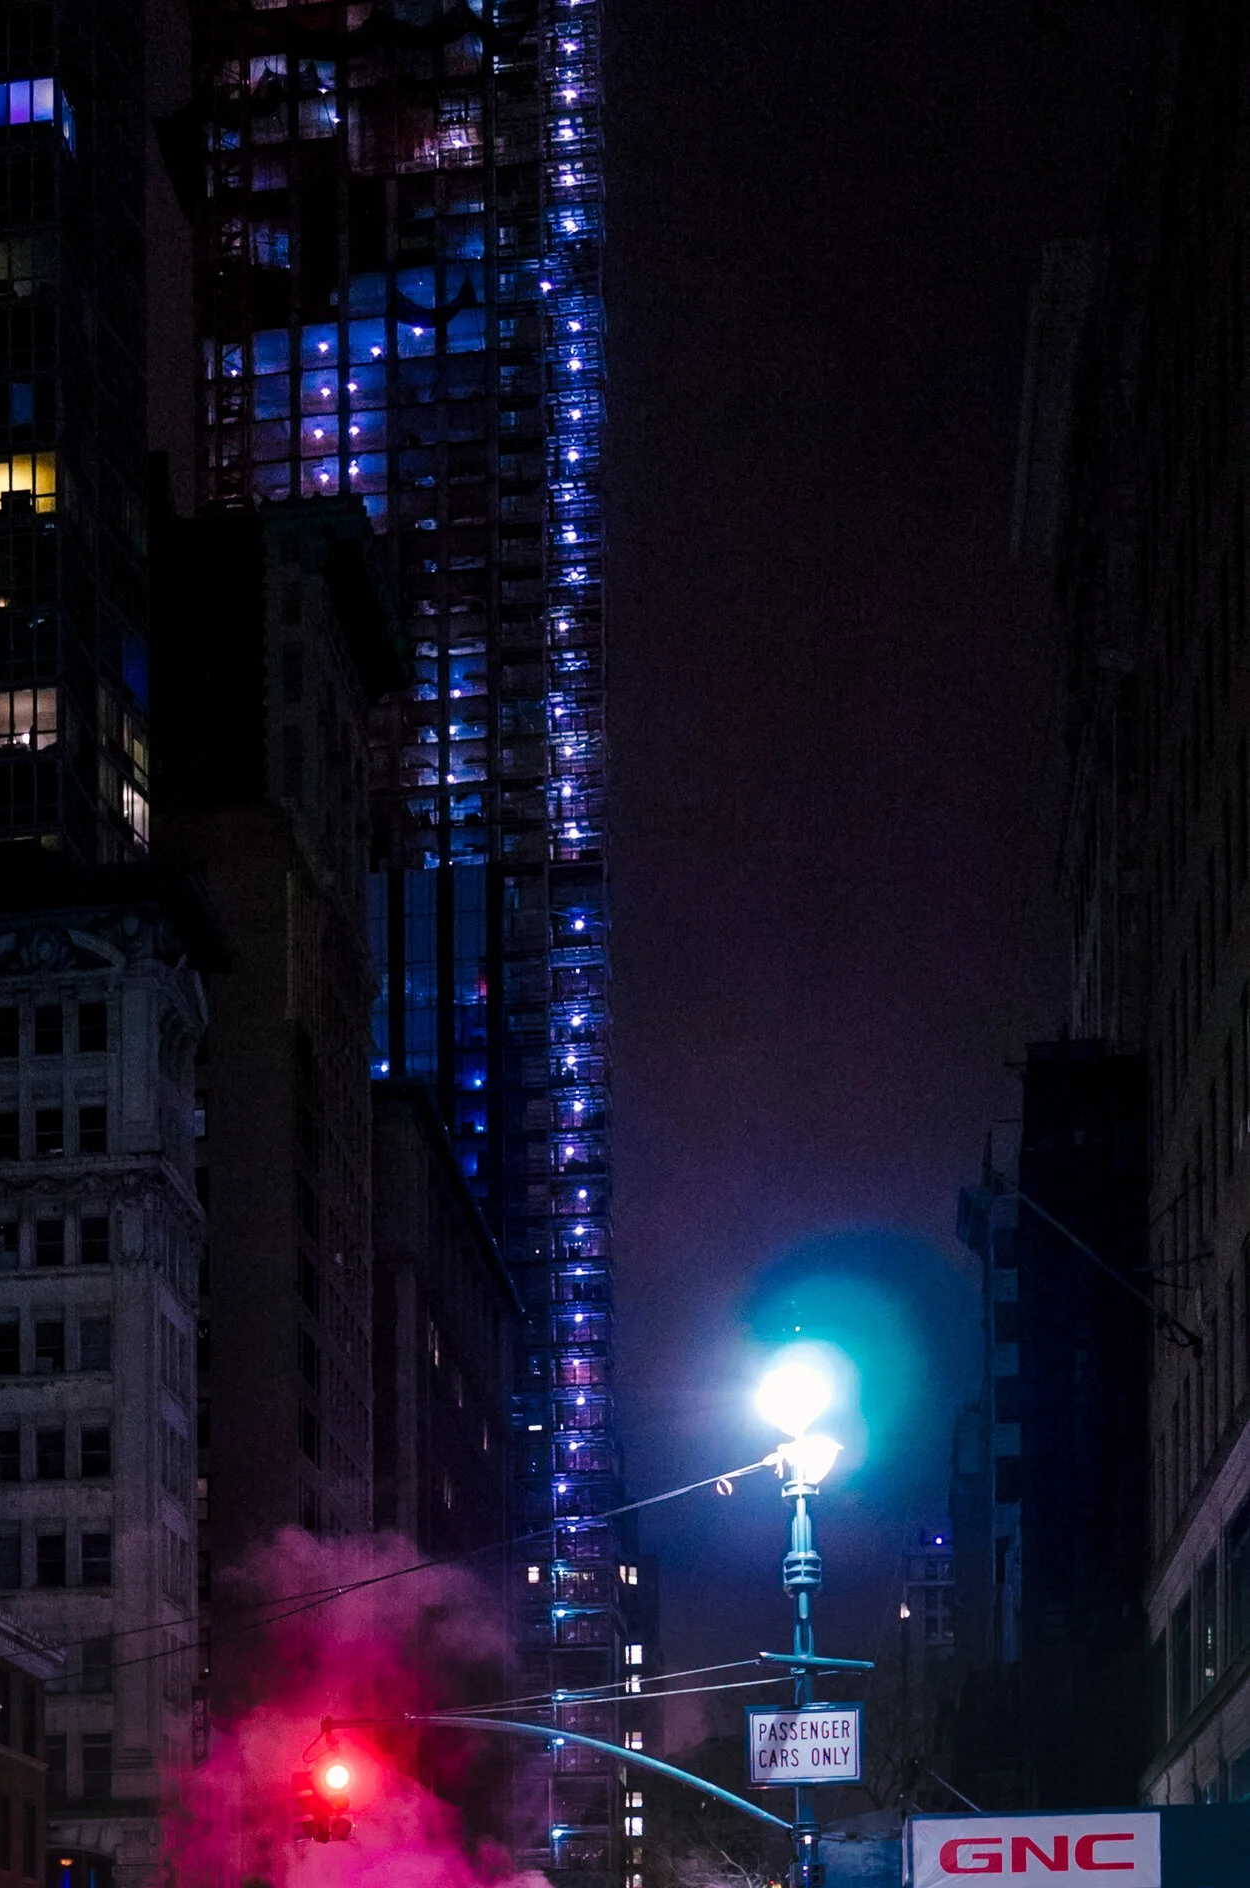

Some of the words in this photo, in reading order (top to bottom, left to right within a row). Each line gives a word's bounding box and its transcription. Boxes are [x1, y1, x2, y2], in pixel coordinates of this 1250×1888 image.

[758, 1720, 851, 1741] PASSENGER
[758, 1748, 799, 1768] CARS
[811, 1746, 851, 1766] ONLY
[939, 1833, 1135, 1874] GNC
